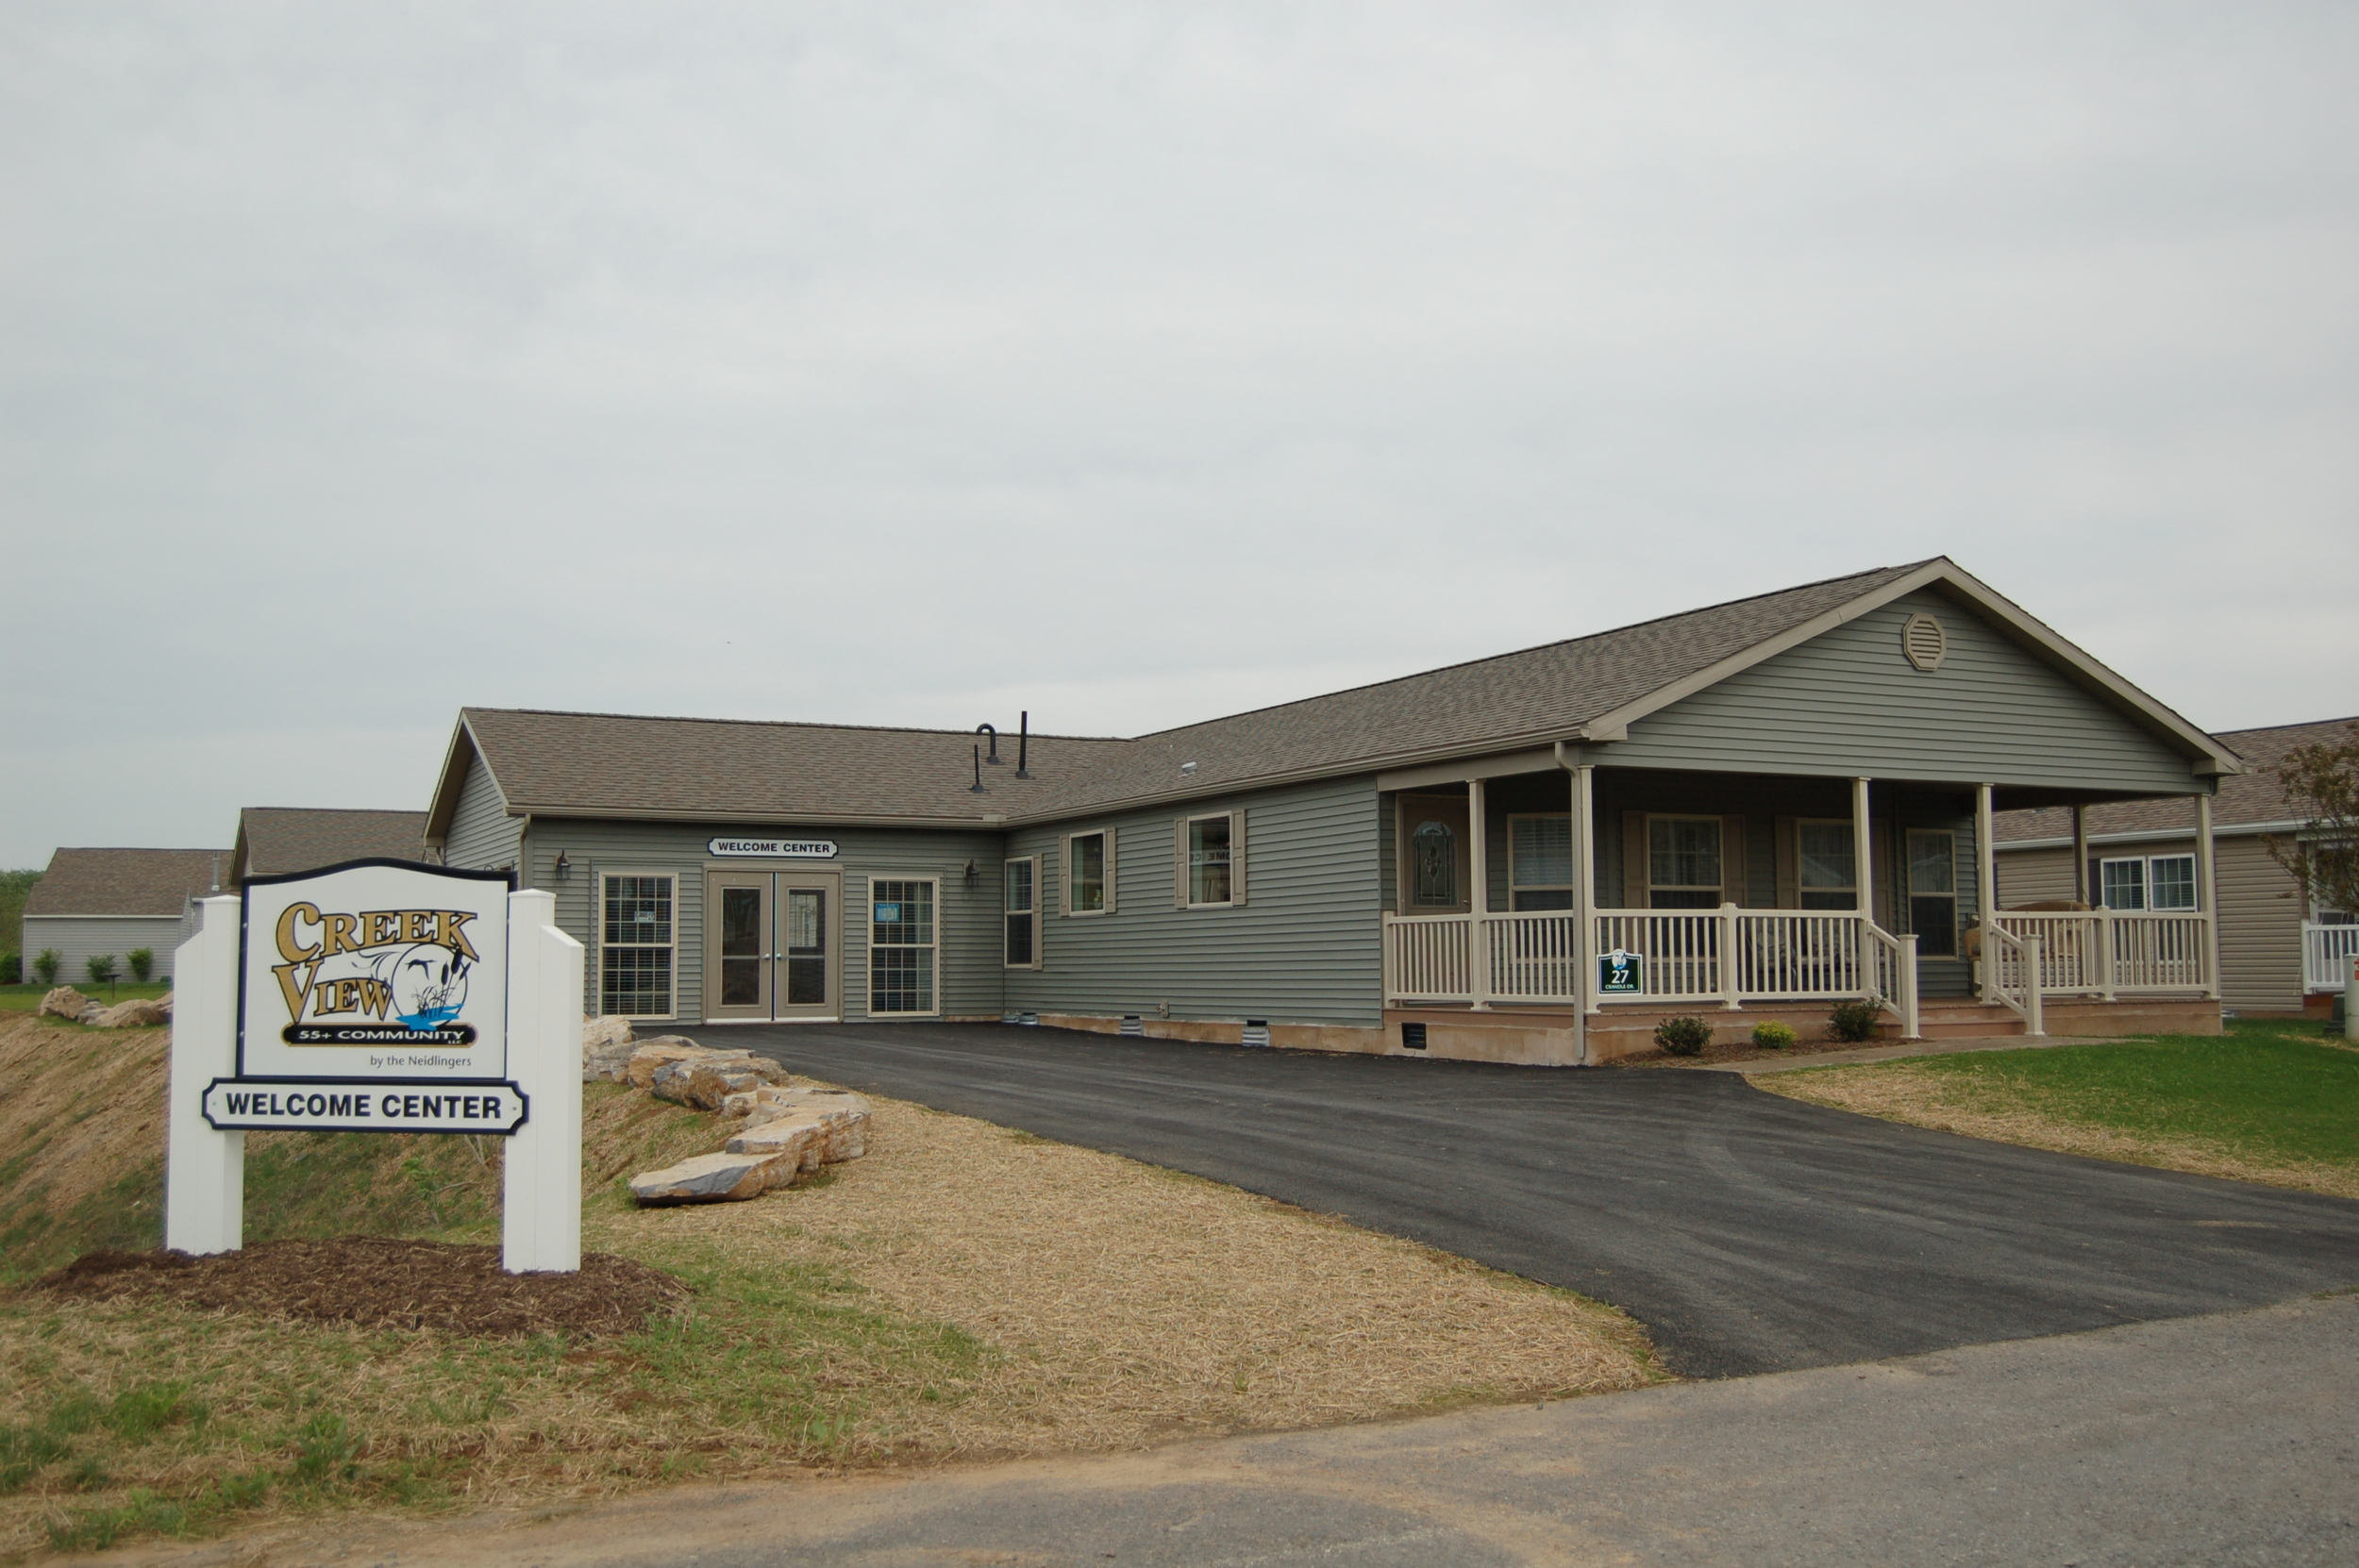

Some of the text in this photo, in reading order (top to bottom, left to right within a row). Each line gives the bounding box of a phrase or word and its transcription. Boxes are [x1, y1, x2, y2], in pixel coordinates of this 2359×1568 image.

[718, 842, 830, 853] WELCOME CENTER
[276, 901, 479, 963] CREEK
[1611, 969, 1630, 984] 27
[272, 959, 393, 1025] VIEW
[299, 1030, 465, 1040] 55+ COMMUNITY
[370, 1055, 472, 1069] by the Neidlingers
[226, 1092, 502, 1120] WELCOME CENTER
